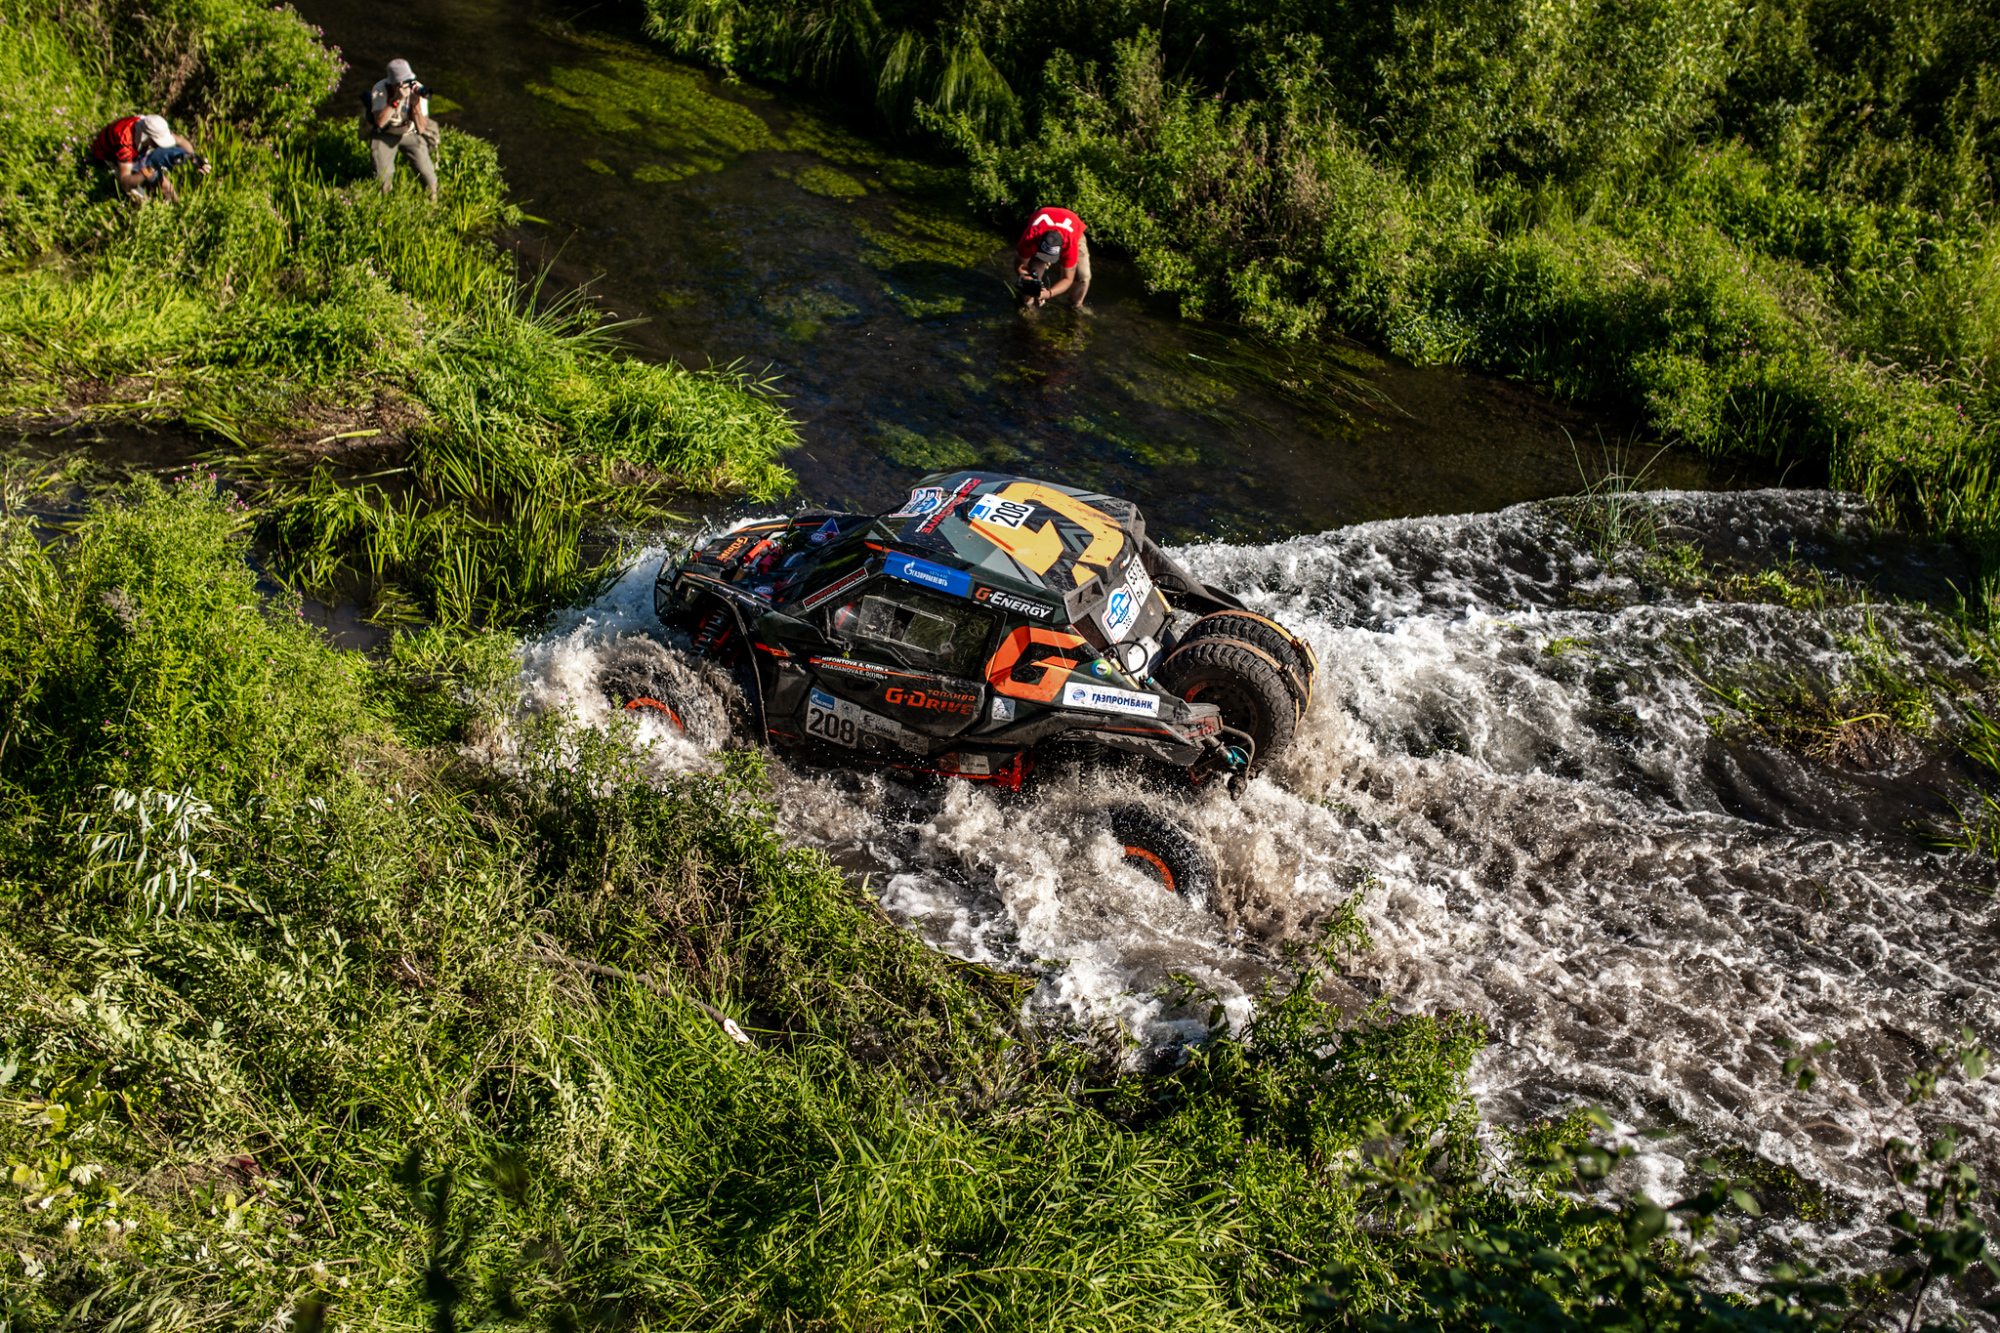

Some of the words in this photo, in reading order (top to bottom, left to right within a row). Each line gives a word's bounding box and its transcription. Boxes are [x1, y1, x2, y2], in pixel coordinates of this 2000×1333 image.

[990, 501, 1030, 528] 208
[1091, 693, 1153, 710] ГАЗПРОМБАНК
[808, 707, 856, 745] 208
